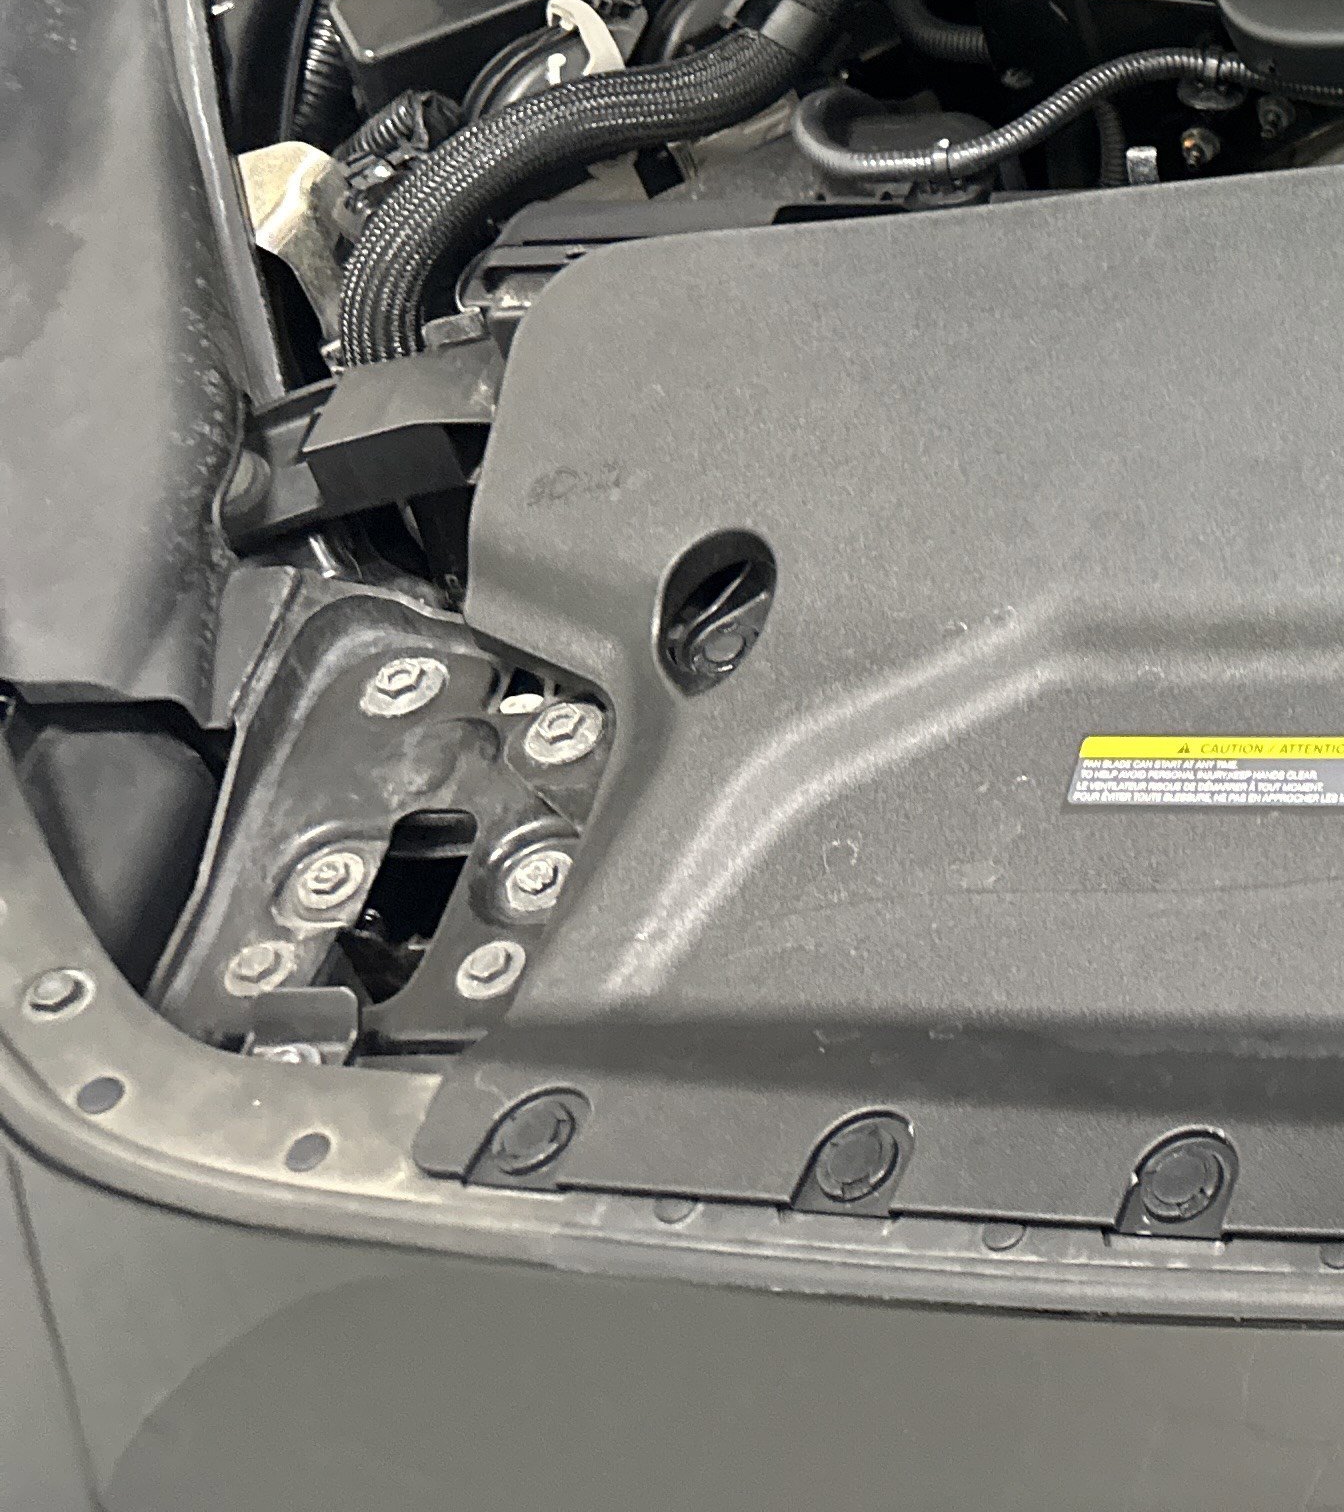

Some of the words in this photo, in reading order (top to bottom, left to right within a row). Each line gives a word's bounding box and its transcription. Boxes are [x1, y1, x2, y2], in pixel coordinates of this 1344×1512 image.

[1200, 743, 1264, 754] CAUTION
[1083, 759, 1101, 769] FAN
[1102, 759, 1131, 769] BLADE
[1133, 759, 1153, 769] CAN
[1154, 759, 1182, 769] START
[1183, 759, 1195, 769] AT
[1195, 759, 1215, 769] ANY
[1081, 769, 1093, 779] TO
[1094, 769, 1118, 779] HELP
[1118, 769, 1146, 779] AVOID
[1148, 769, 1195, 780] PERSONAL
